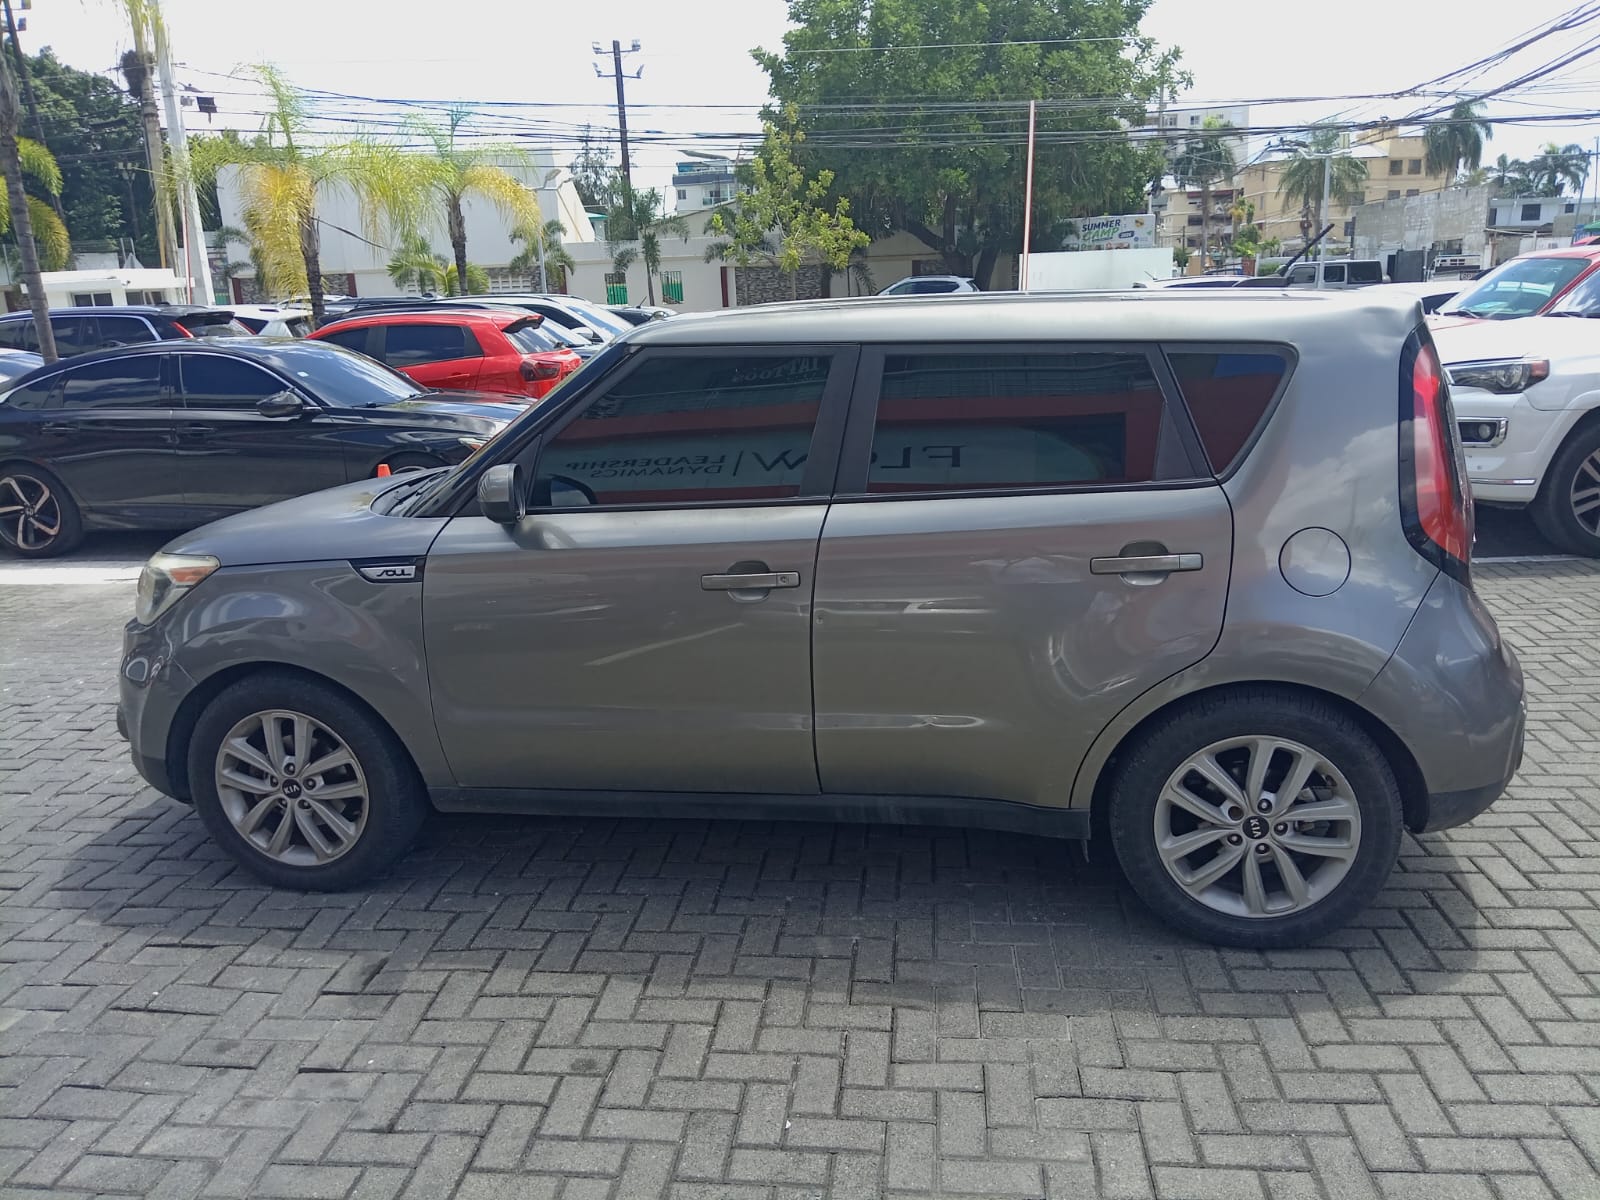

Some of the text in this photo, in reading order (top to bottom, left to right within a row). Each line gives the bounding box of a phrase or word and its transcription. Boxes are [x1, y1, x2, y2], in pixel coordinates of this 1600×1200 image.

[1082, 218, 1121, 233] SUMMER
[1082, 227, 1119, 242] CAMP
[376, 568, 412, 577] SOUL
[283, 785, 300, 795] KIA
[1249, 818, 1260, 839] KIA
